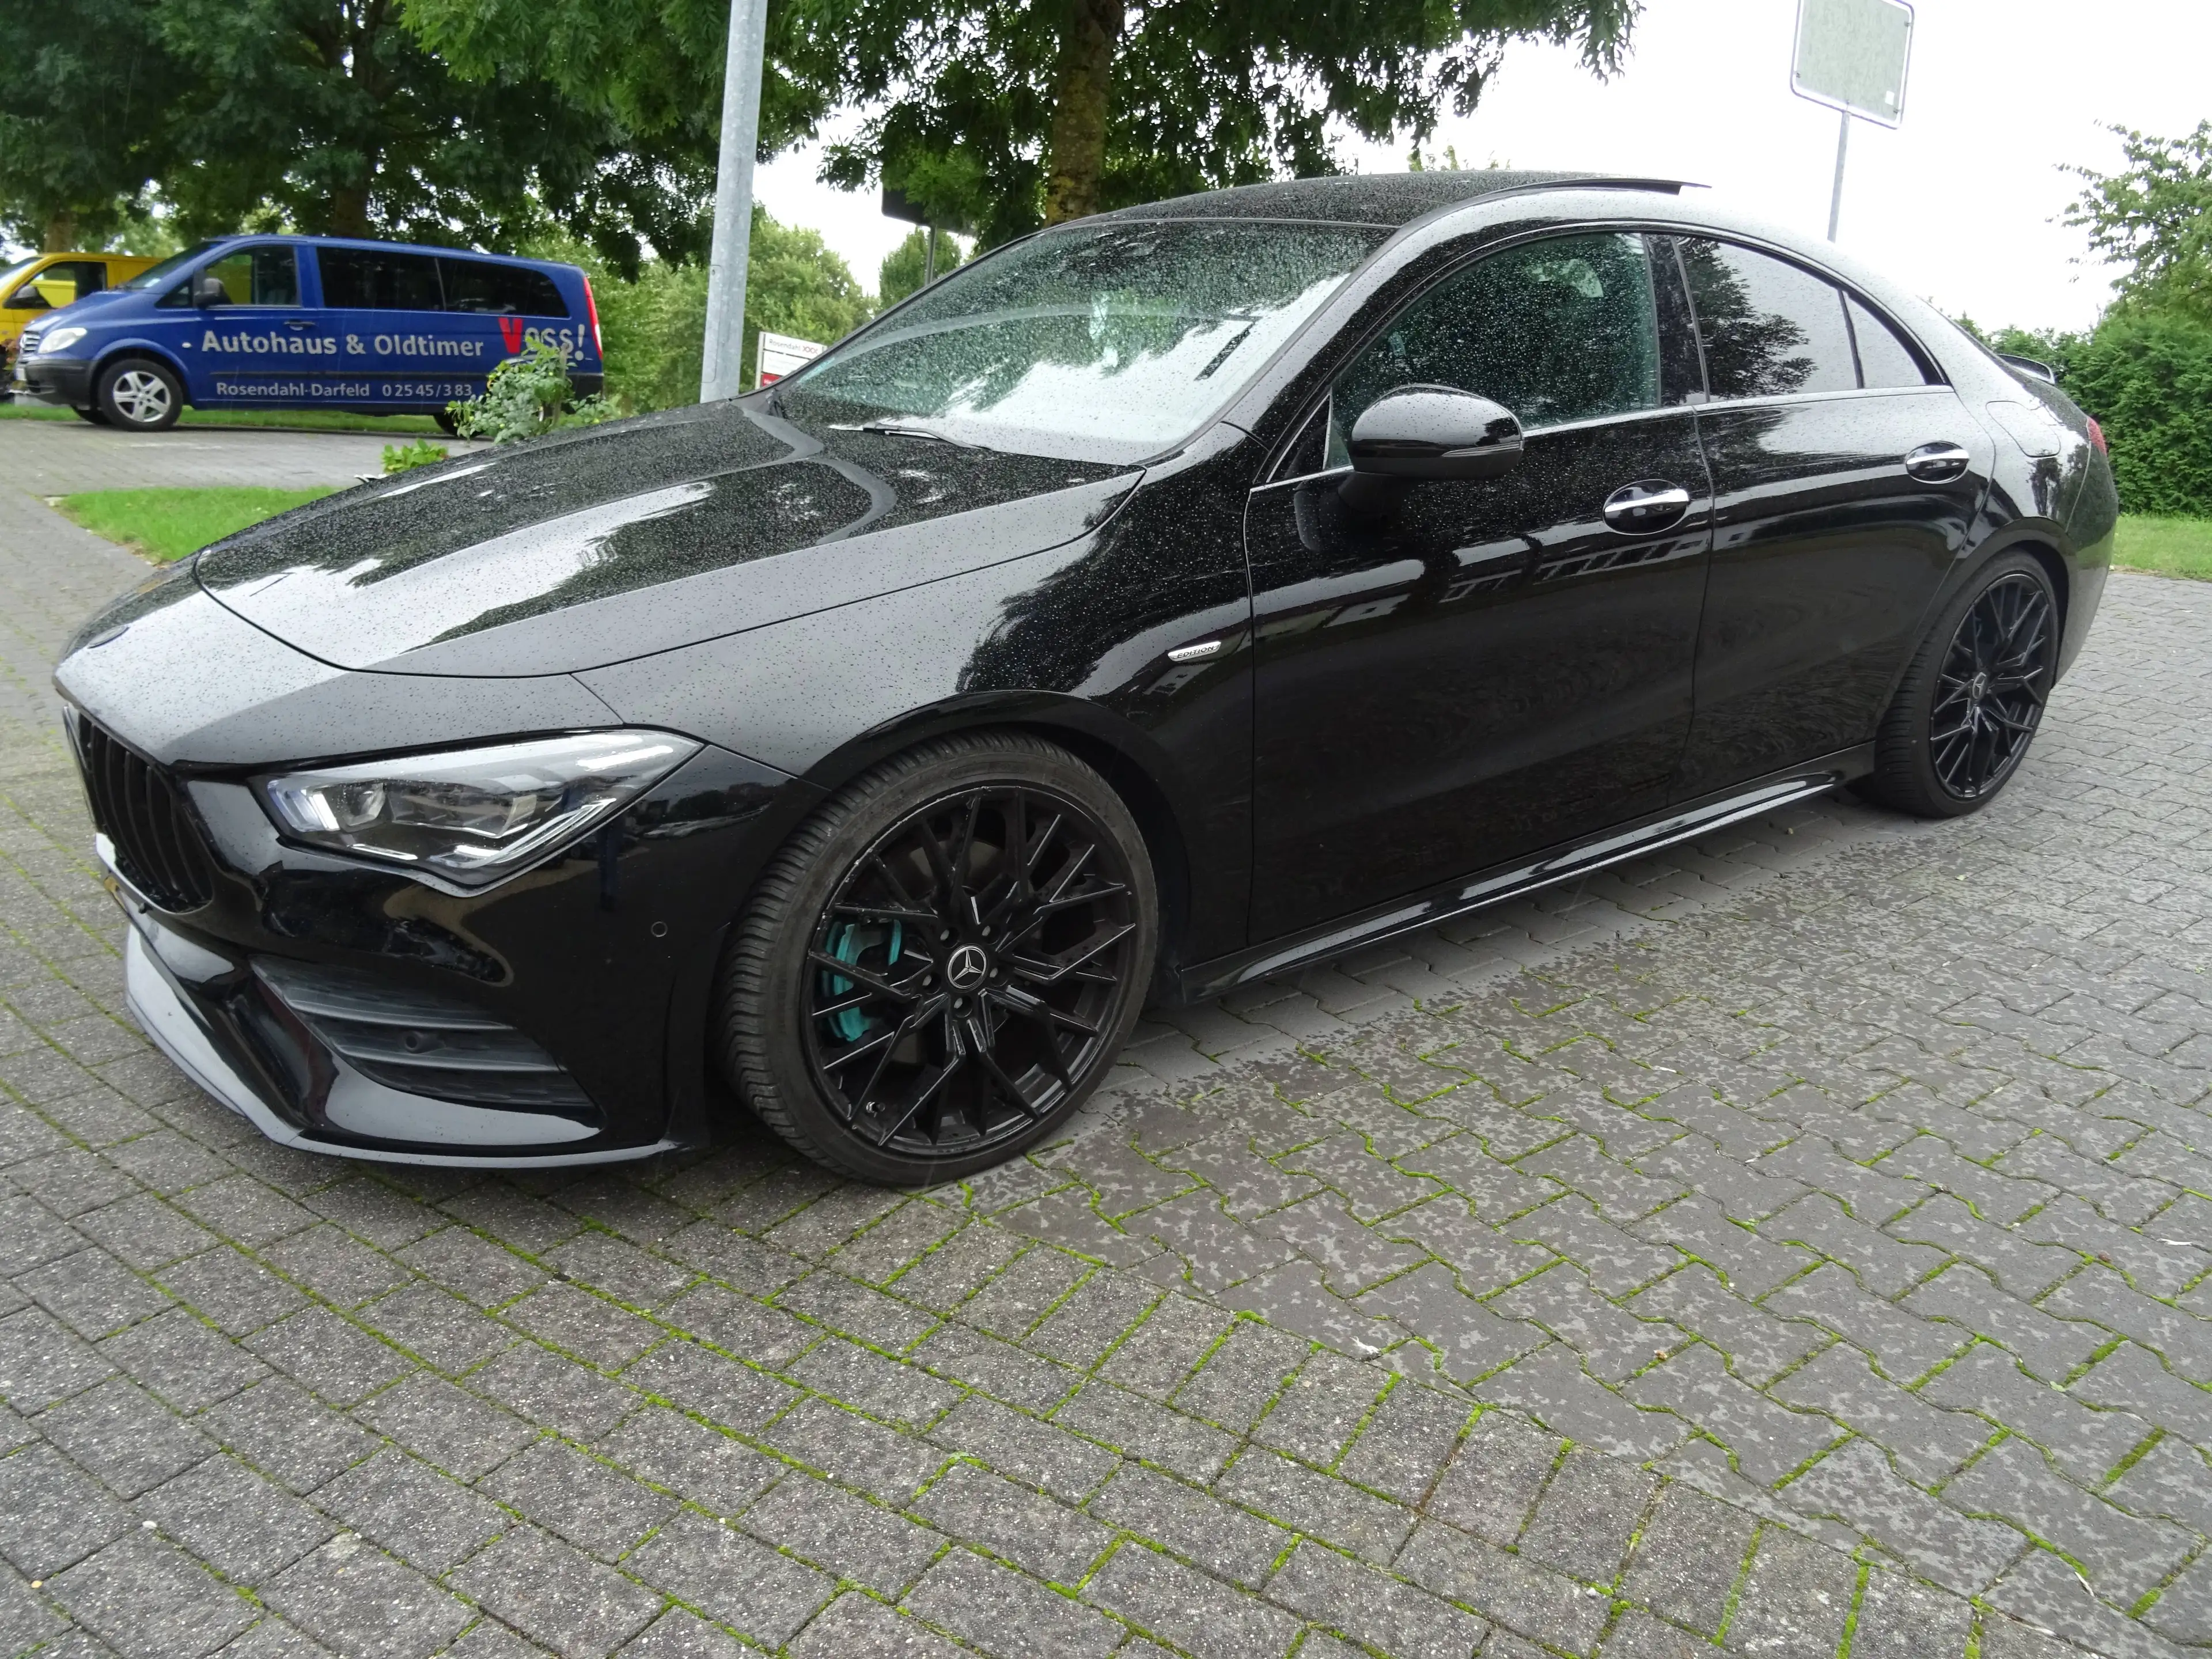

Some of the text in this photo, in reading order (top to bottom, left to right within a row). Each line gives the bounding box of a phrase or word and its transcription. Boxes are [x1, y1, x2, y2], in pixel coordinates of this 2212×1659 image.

[202, 330, 336, 355] Autohaus
[347, 334, 366, 355] &
[374, 335, 484, 356] Oldtimer
[216, 382, 370, 396] Rosendahl-Darfeld
[1177, 645, 1214, 658] EDITION
